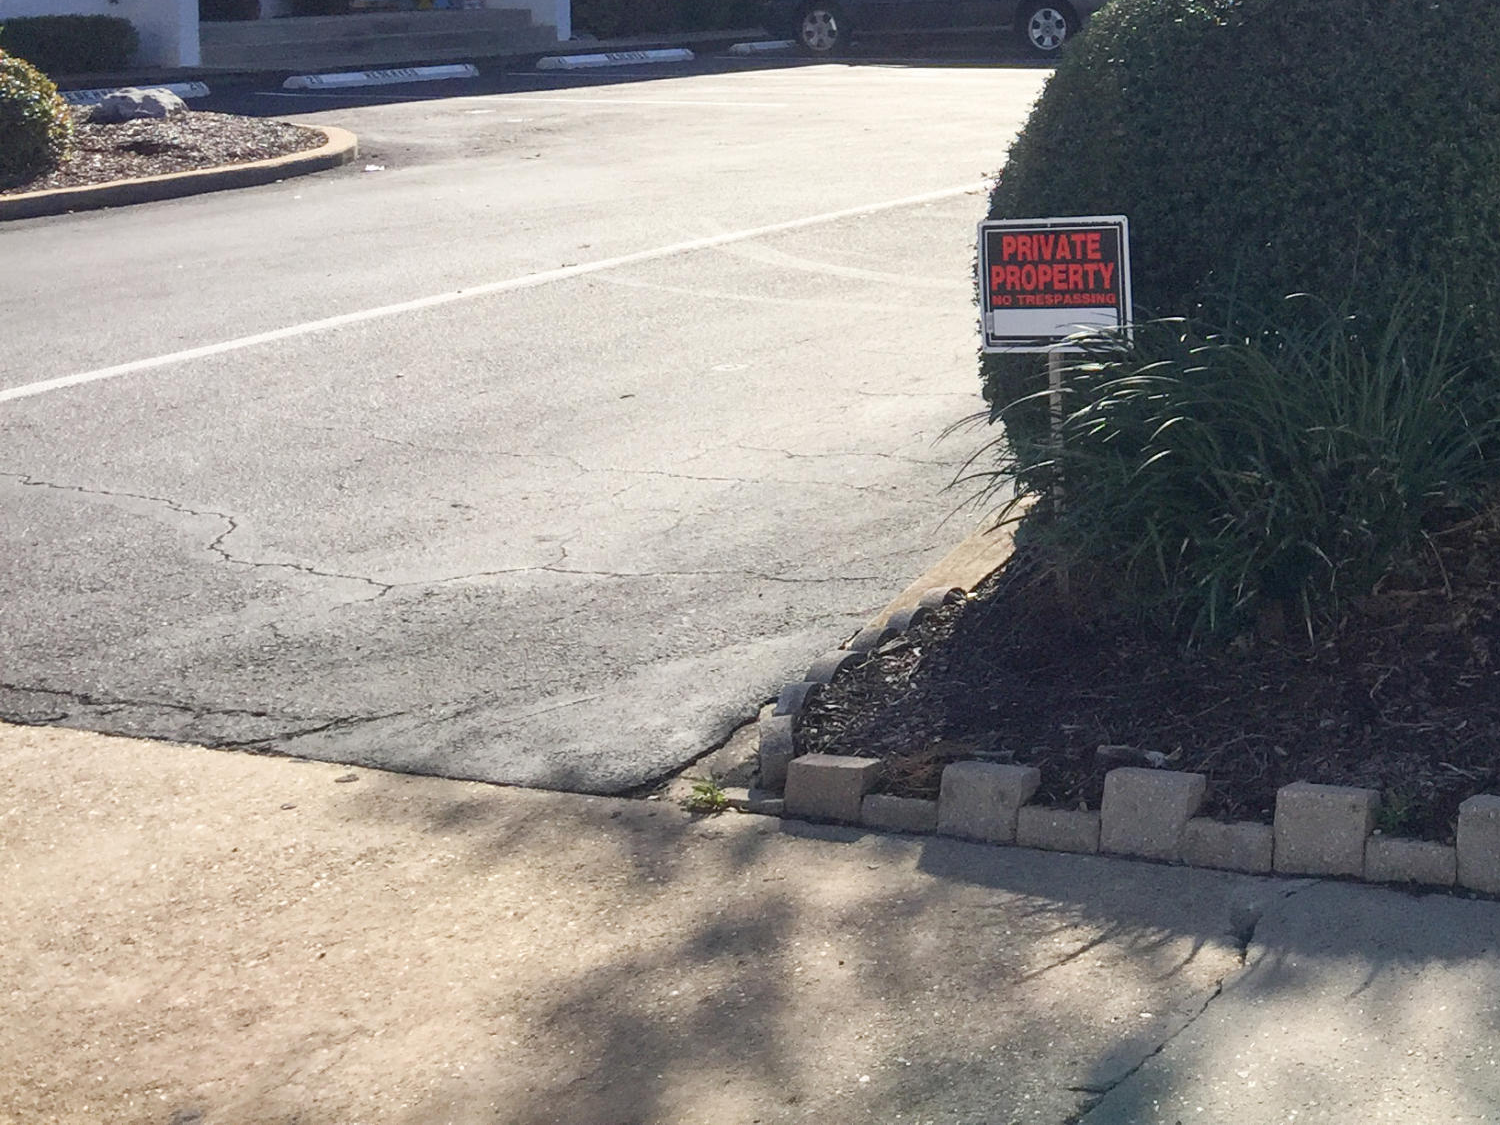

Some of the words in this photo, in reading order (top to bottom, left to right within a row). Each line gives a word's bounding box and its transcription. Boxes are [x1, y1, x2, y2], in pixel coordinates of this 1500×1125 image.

[1002, 233, 1101, 261] PRIVATE
[991, 263, 1114, 291] PROPERTY
[992, 294, 1012, 305] NO
[1016, 292, 1116, 306] TRESPASSING
